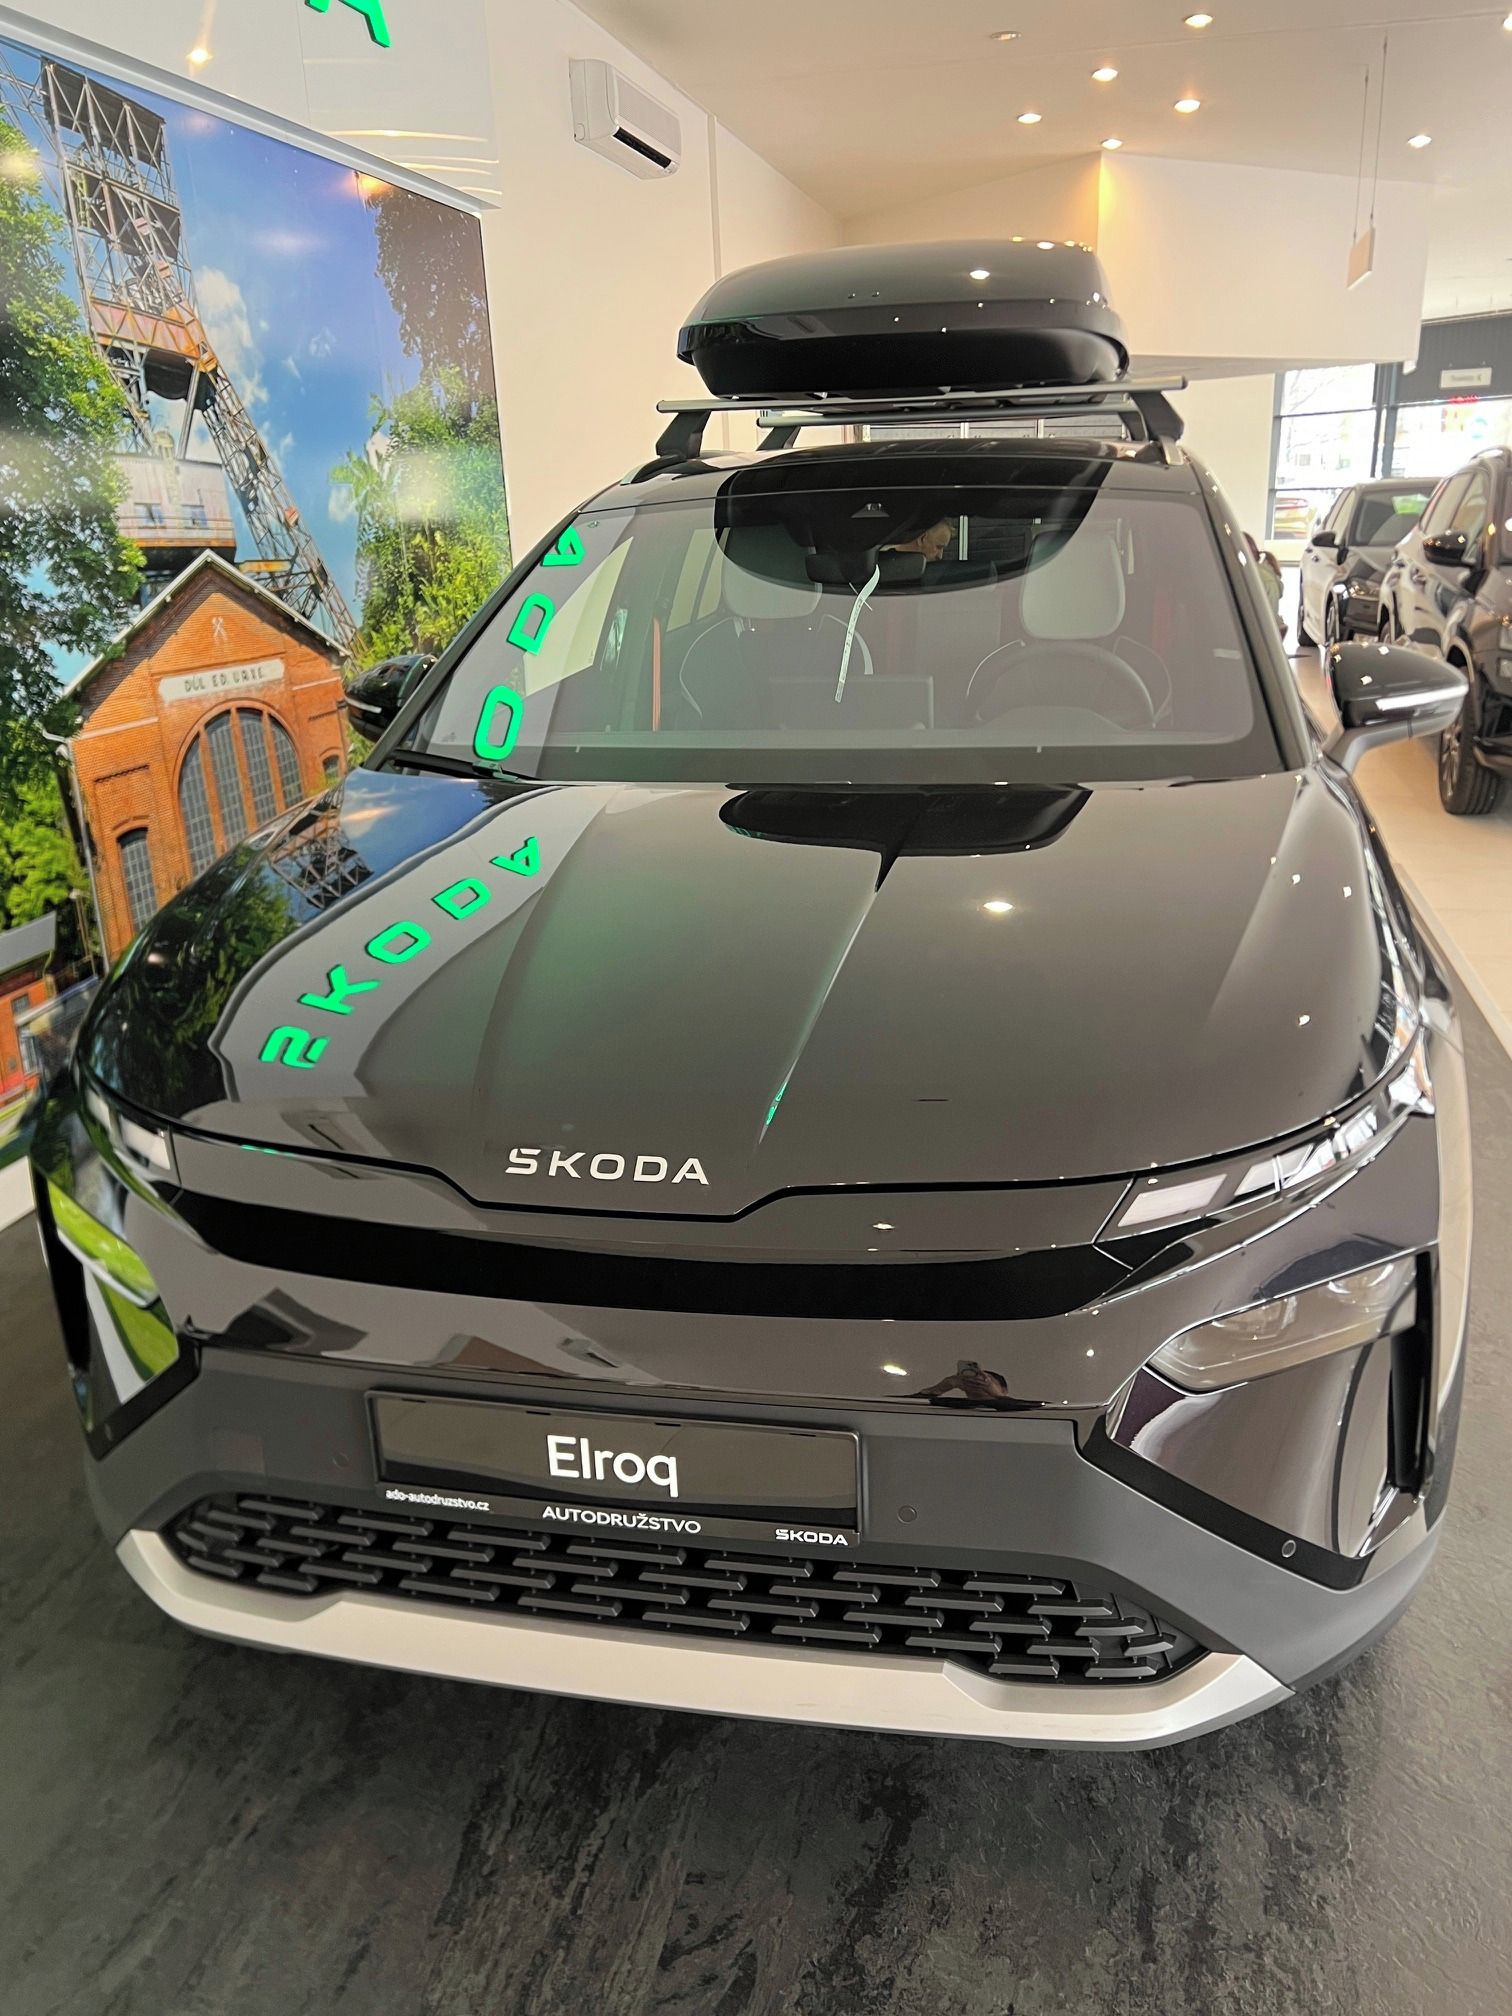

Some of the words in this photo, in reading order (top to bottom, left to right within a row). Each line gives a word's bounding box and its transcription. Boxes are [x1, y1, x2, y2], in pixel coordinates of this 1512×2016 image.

[546, 1434, 679, 1497] Elroq
[385, 1488, 490, 1511] ado-autodruzstvo.cz
[542, 1505, 702, 1534] AUTODRUŽSTVO
